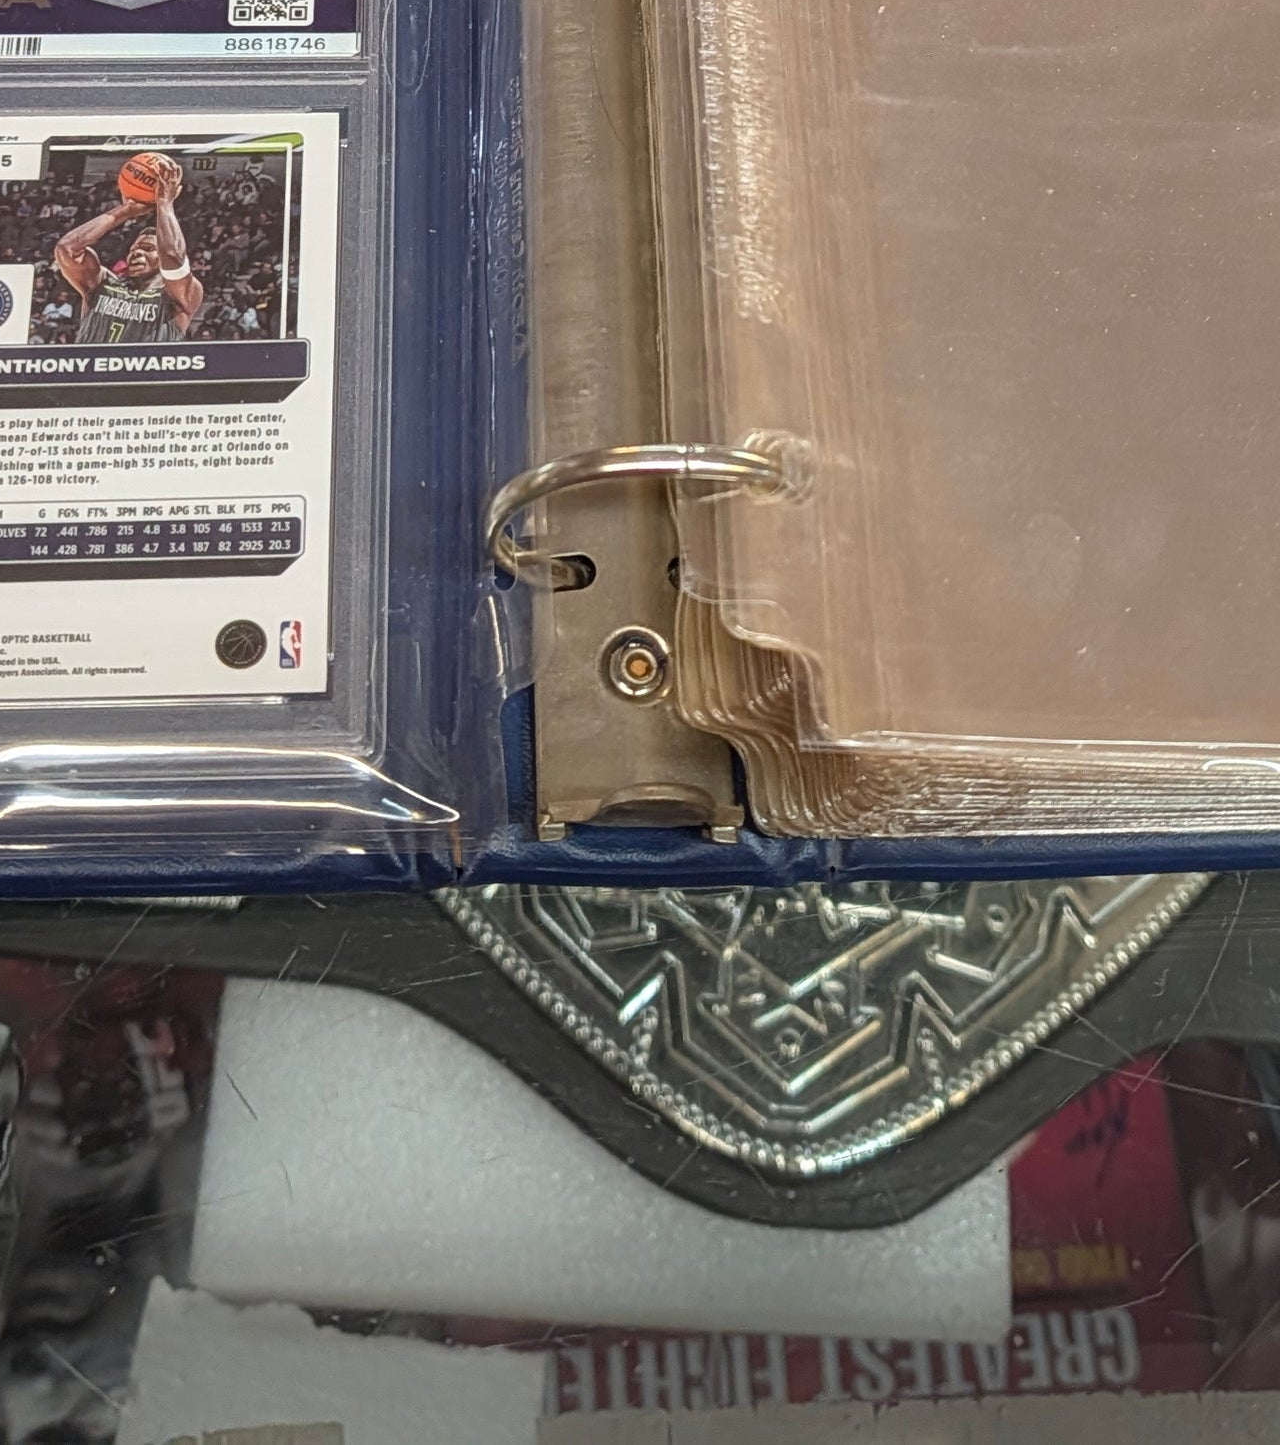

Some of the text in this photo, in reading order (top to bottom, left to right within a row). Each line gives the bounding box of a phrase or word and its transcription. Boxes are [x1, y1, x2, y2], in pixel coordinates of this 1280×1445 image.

[224, 37, 327, 51] 88618746
[93, 355, 206, 372] EDWARDS
[8, 419, 33, 431] play
[36, 417, 58, 428] half
[62, 417, 75, 427] of
[78, 416, 104, 427] their
[108, 417, 144, 429] games
[147, 414, 182, 426] inside
[185, 414, 203, 425] the
[207, 414, 243, 426] Target
[246, 413, 286, 424] Center,
[38, 509, 46, 518] G
[57, 508, 79, 518] FG%
[87, 507, 108, 518] FT%
[116, 506, 137, 517] 3PM
[143, 506, 163, 517] RPG
[168, 505, 190, 516] APG
[194, 505, 211, 515] STL
[217, 504, 236, 514] BLK
[243, 504, 262, 514] PTS
[271, 503, 291, 513] PPG
[35, 527, 48, 537] 72
[56, 526, 78, 537] .441
[85, 526, 107, 536] .786
[118, 525, 135, 535] 215
[143, 524, 161, 535] 4.8
[169, 524, 186, 534] 3.8
[193, 523, 211, 533] 105
[219, 522, 232, 533] 46
[241, 522, 263, 532] 1533
[270, 521, 291, 532] 21.3
[30, 545, 48, 555] 144
[54, 545, 77, 555] .428
[85, 544, 106, 554] .781
[115, 543, 134, 554] 386
[142, 543, 159, 553] 4.7
[169, 542, 186, 552] 3.4
[192, 541, 209, 551] 187
[218, 541, 232, 551] 82
[239, 540, 264, 550] 2925
[268, 539, 291, 550] 20.3
[1, 634, 30, 644] OPTIC
[32, 633, 91, 644] BASKETBALL
